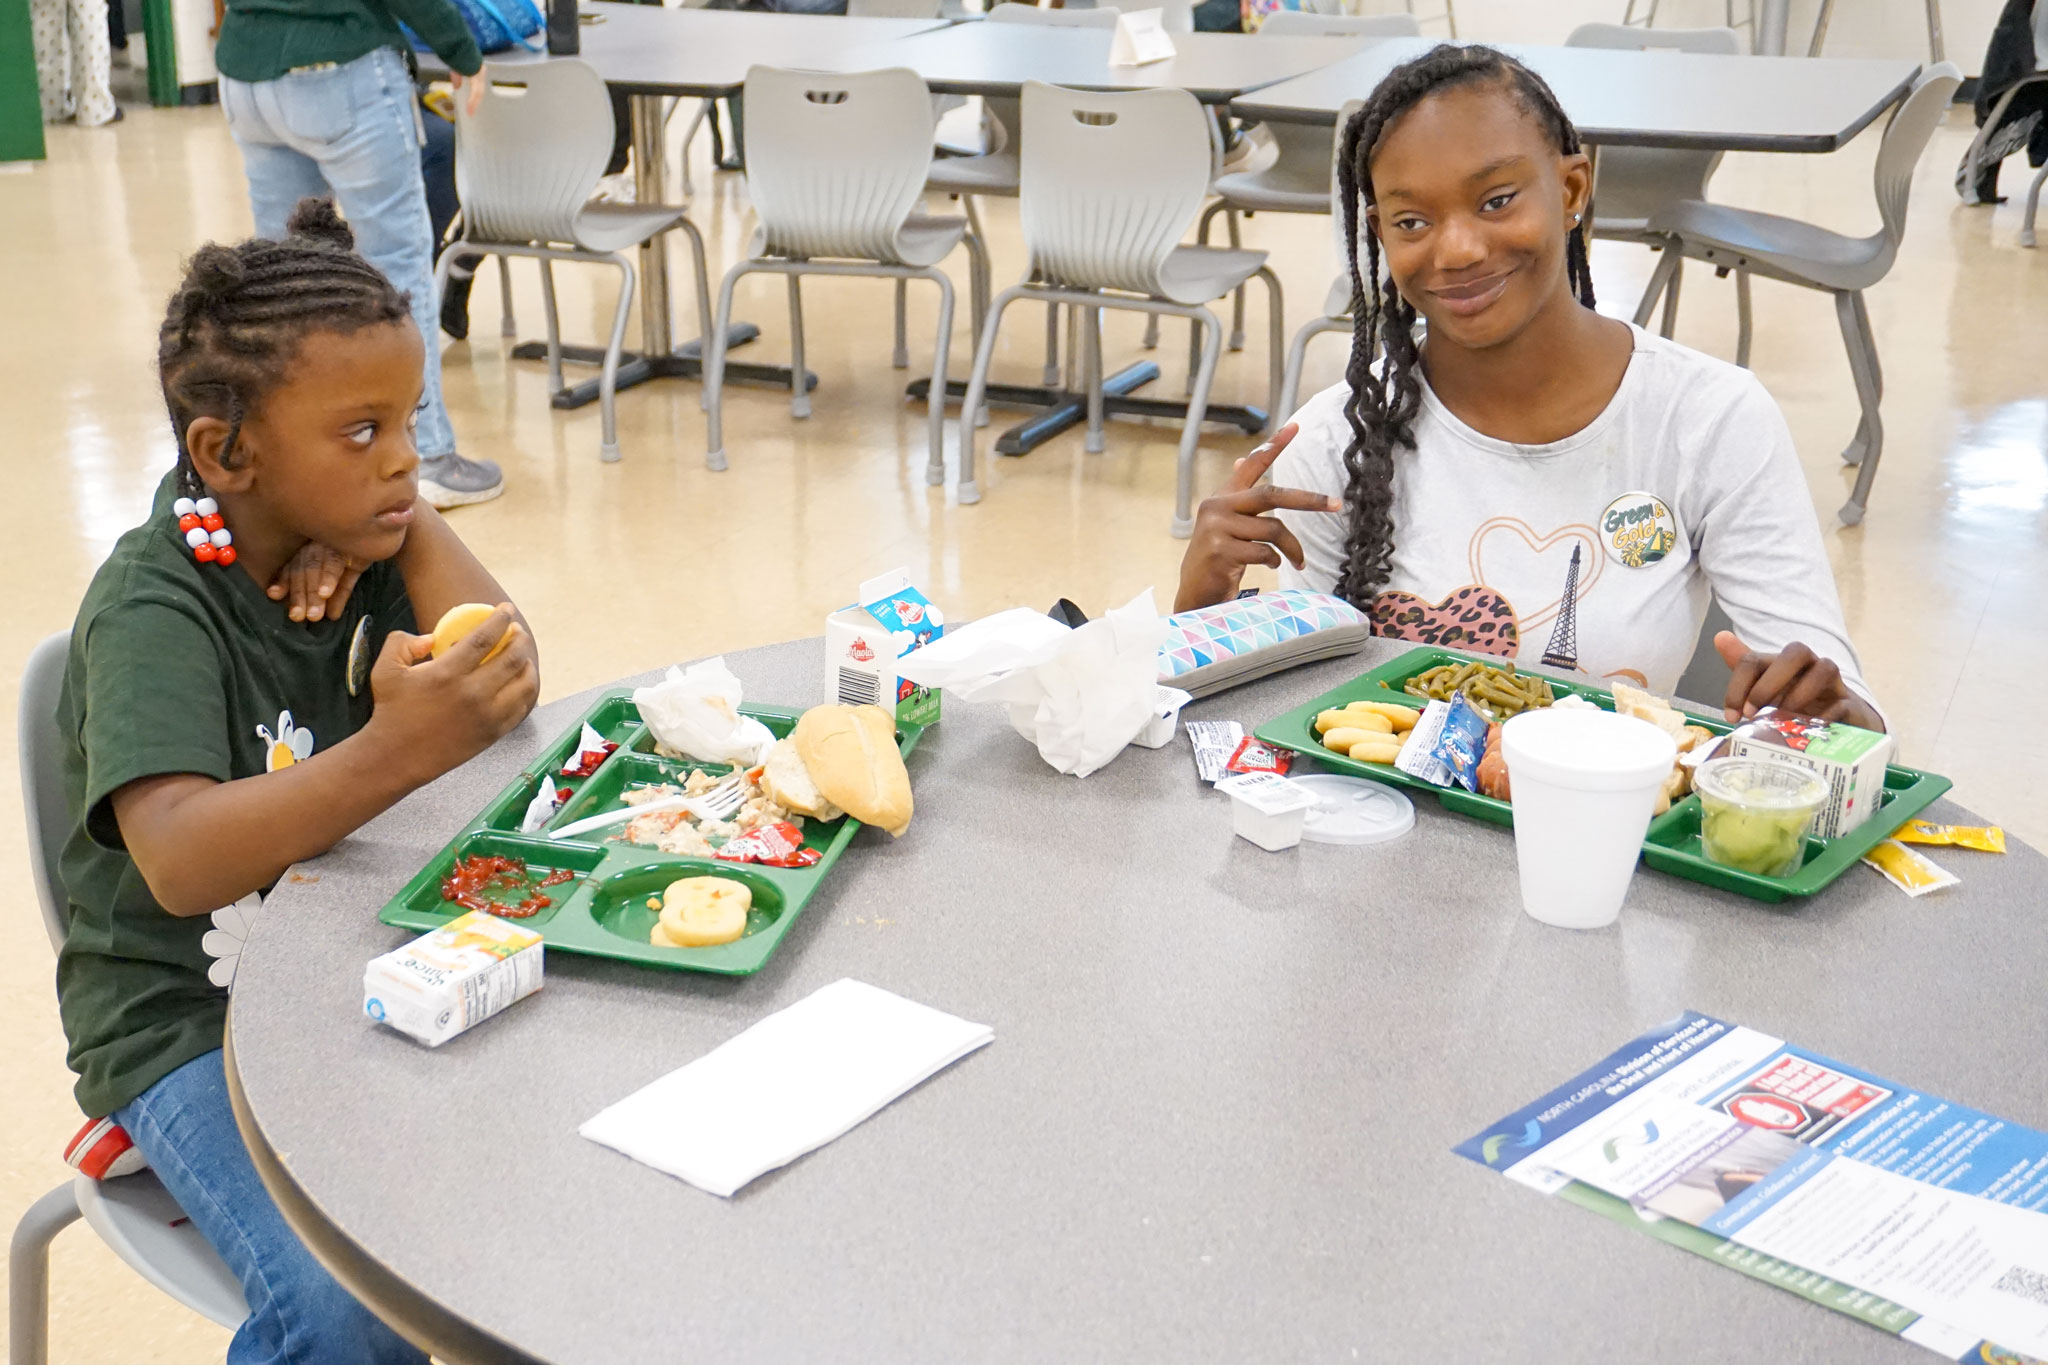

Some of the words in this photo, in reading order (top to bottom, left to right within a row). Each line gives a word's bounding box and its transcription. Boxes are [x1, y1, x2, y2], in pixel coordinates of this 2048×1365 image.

[1604, 503, 1654, 533] Green
[1654, 503, 1665, 519] &
[1612, 518, 1656, 549] Gold
[846, 642, 874, 661] Maola
[1622, 1070, 1644, 1085] Deaf
[1644, 1059, 1661, 1074] and
[1659, 1048, 1681, 1064] Hard
[1688, 1023, 1723, 1045] Hearing
[1537, 1101, 1572, 1121] NORTH
[1571, 1073, 1618, 1102] CAROLINA
[1616, 1053, 1651, 1075] Division
[1659, 1024, 1696, 1049] Services
